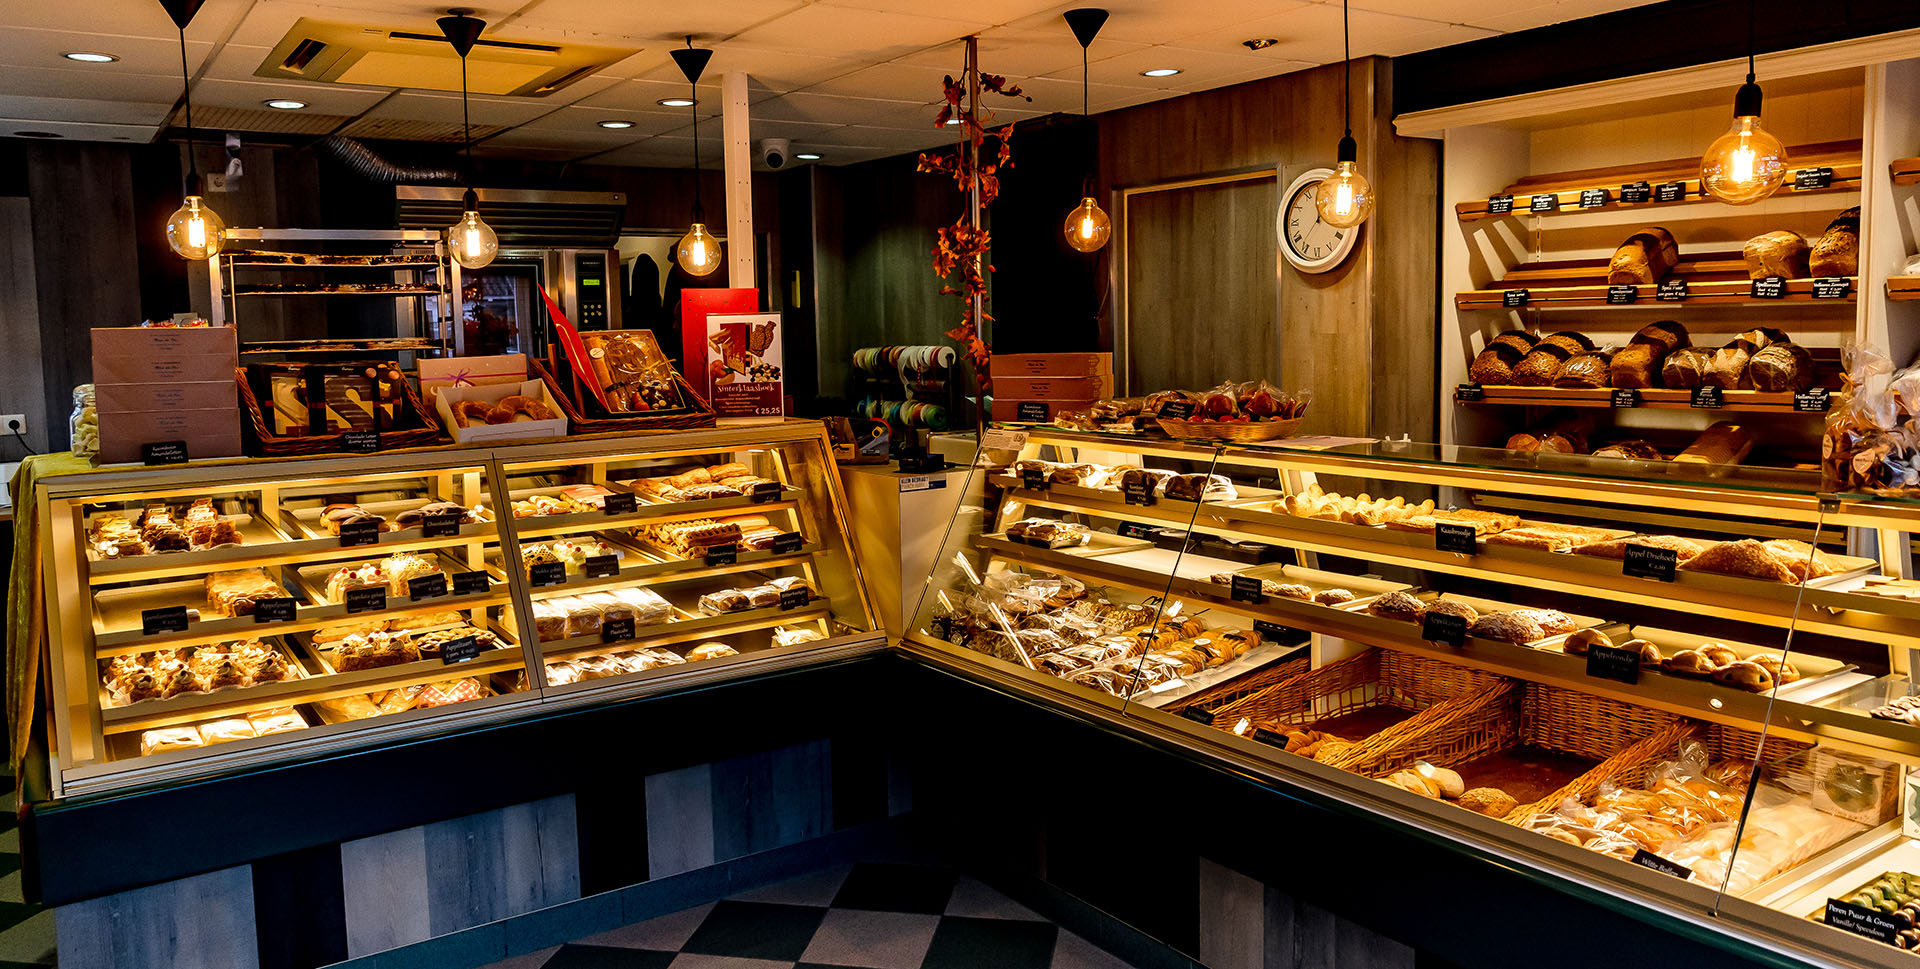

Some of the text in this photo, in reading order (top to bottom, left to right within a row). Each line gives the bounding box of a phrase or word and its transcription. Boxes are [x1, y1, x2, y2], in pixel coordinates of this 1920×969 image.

[760, 406, 780, 415] 25,25
[1625, 547, 1676, 563] Appel Driehoek
[1641, 856, 1680, 878] Witte Bollen
[1827, 902, 1896, 931] Peren Puur & Groen
